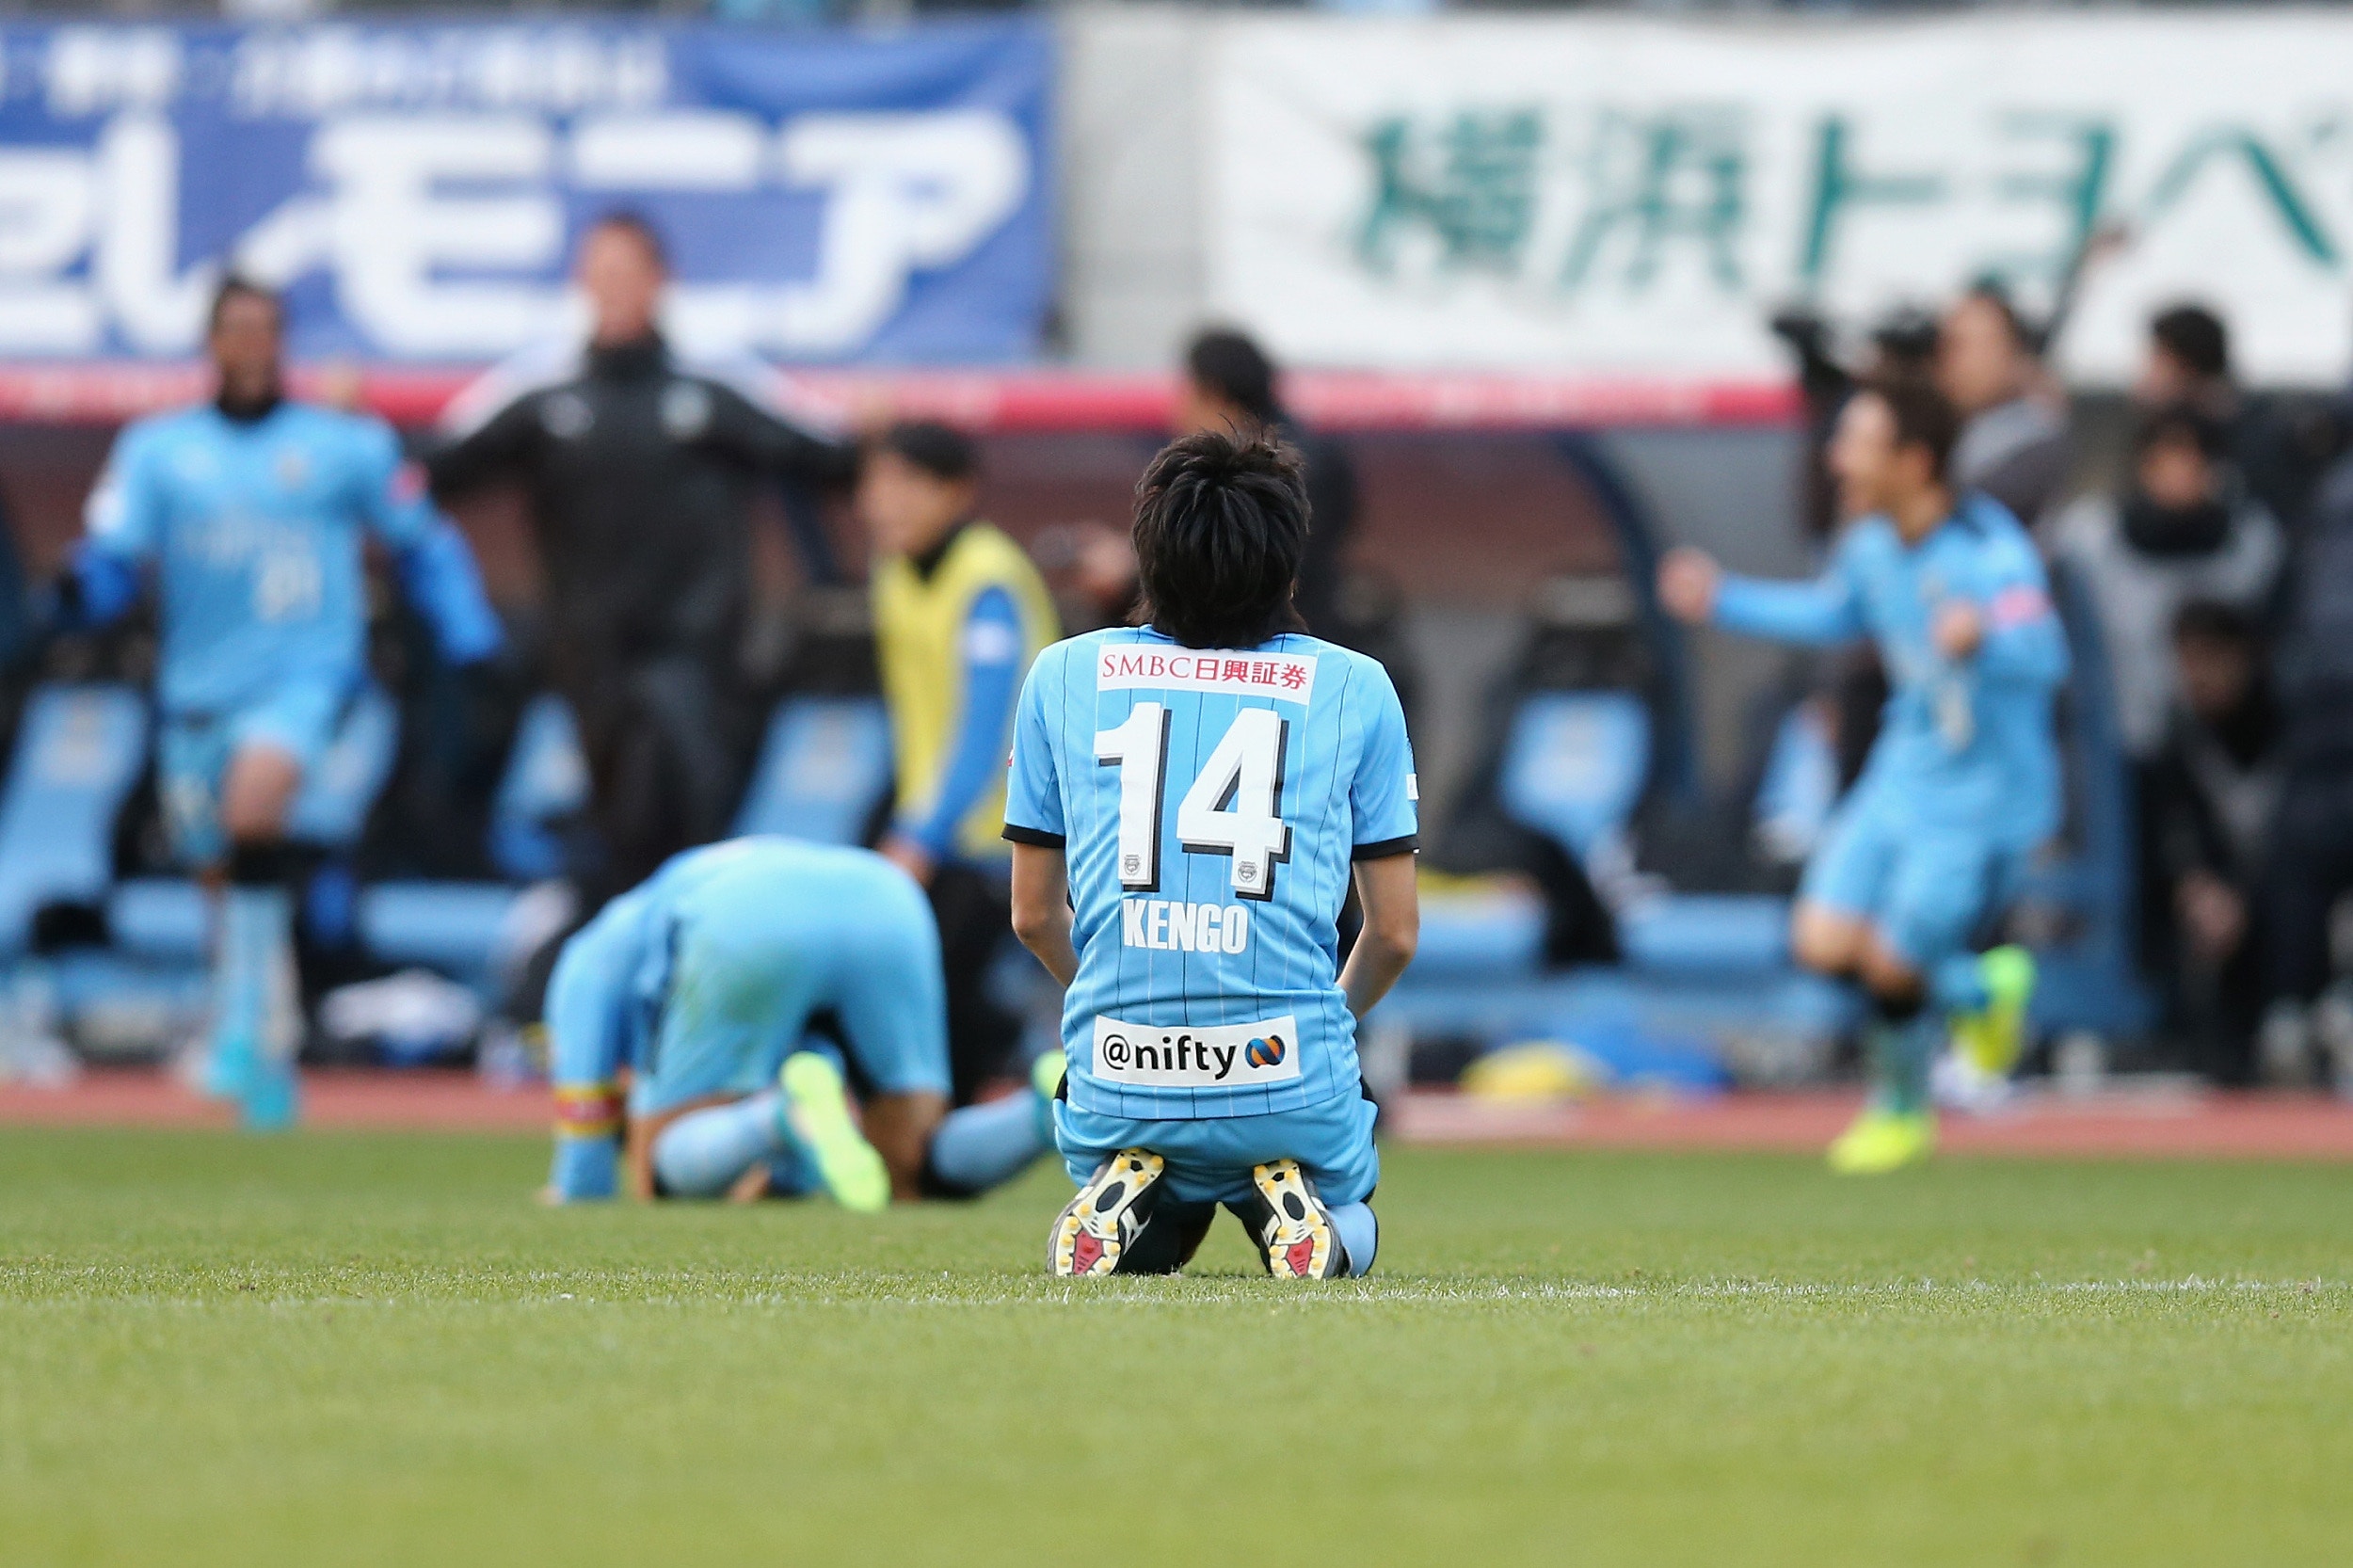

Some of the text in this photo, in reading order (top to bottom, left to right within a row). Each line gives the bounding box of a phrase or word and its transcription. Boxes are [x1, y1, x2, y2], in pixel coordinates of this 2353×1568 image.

[1102, 654, 1307, 690] SMBC日興証券
[1094, 701, 1290, 902] 14
[1123, 898, 1249, 955] KENGO
[1103, 1033, 1238, 1080] @nifty
